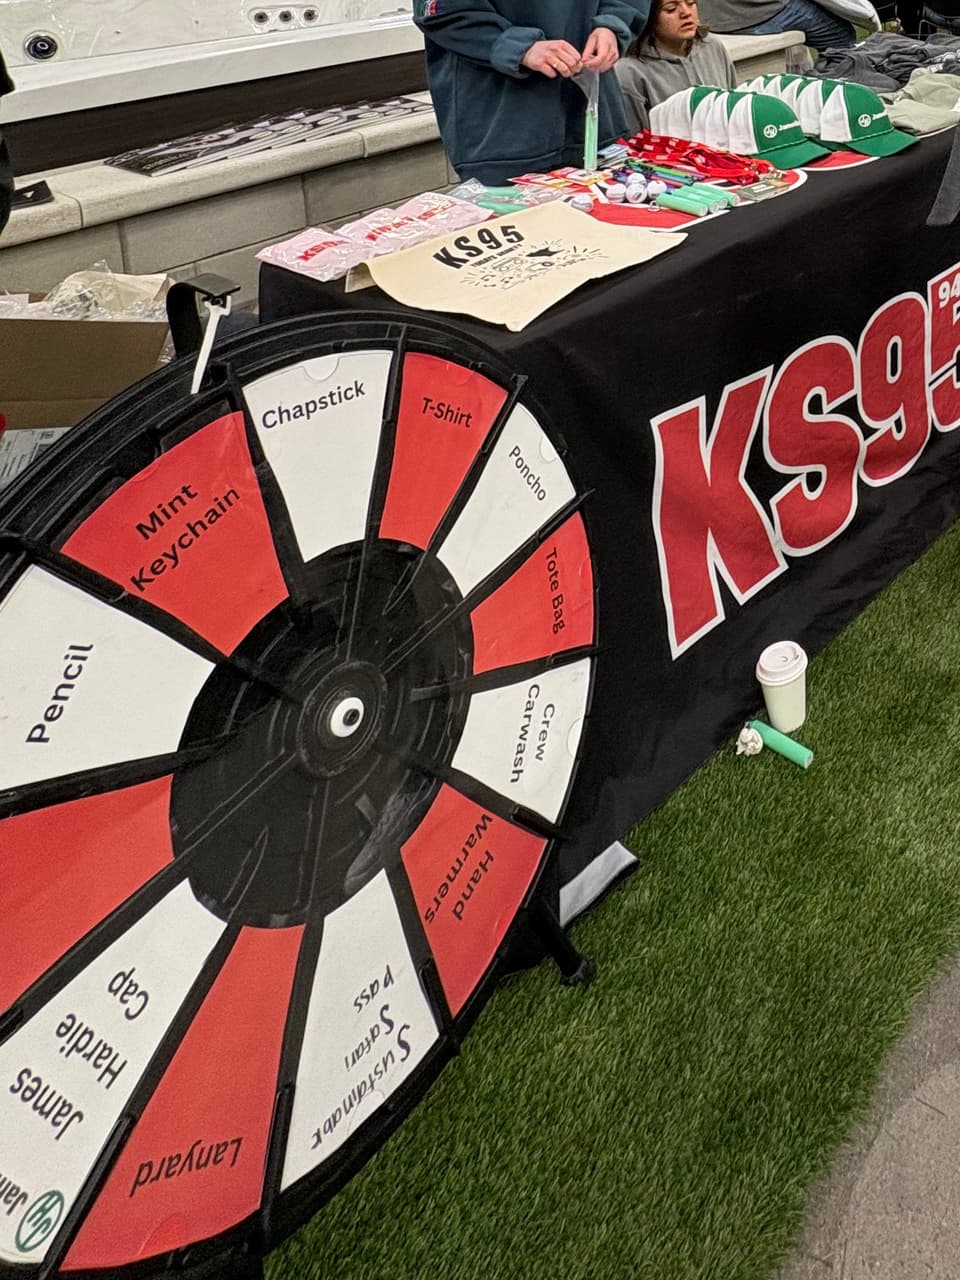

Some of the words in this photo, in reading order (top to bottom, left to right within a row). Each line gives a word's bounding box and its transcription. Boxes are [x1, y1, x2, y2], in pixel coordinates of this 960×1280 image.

[433, 225, 524, 269] KS95
[261, 380, 366, 430] Chapstick
[421, 397, 473, 428] T-Shirt
[509, 445, 547, 501] Poncho
[130, 486, 240, 593] Keychain
[135, 483, 199, 541] Mint
[545, 547, 561, 591] Tote
[552, 594, 566, 635] Bag
[26, 644, 94, 744] Pencil
[510, 683, 541, 784] Carwash
[534, 703, 556, 761] Crew
[425, 814, 493, 926] Warmers
[456, 849, 495, 921] Hand
[107, 967, 150, 1020] Cap
[56, 1013, 128, 1089] Hardie
[344, 1004, 395, 1072] Safari
[9, 1067, 84, 1140] James
[130, 1136, 243, 1198] Lanyard
